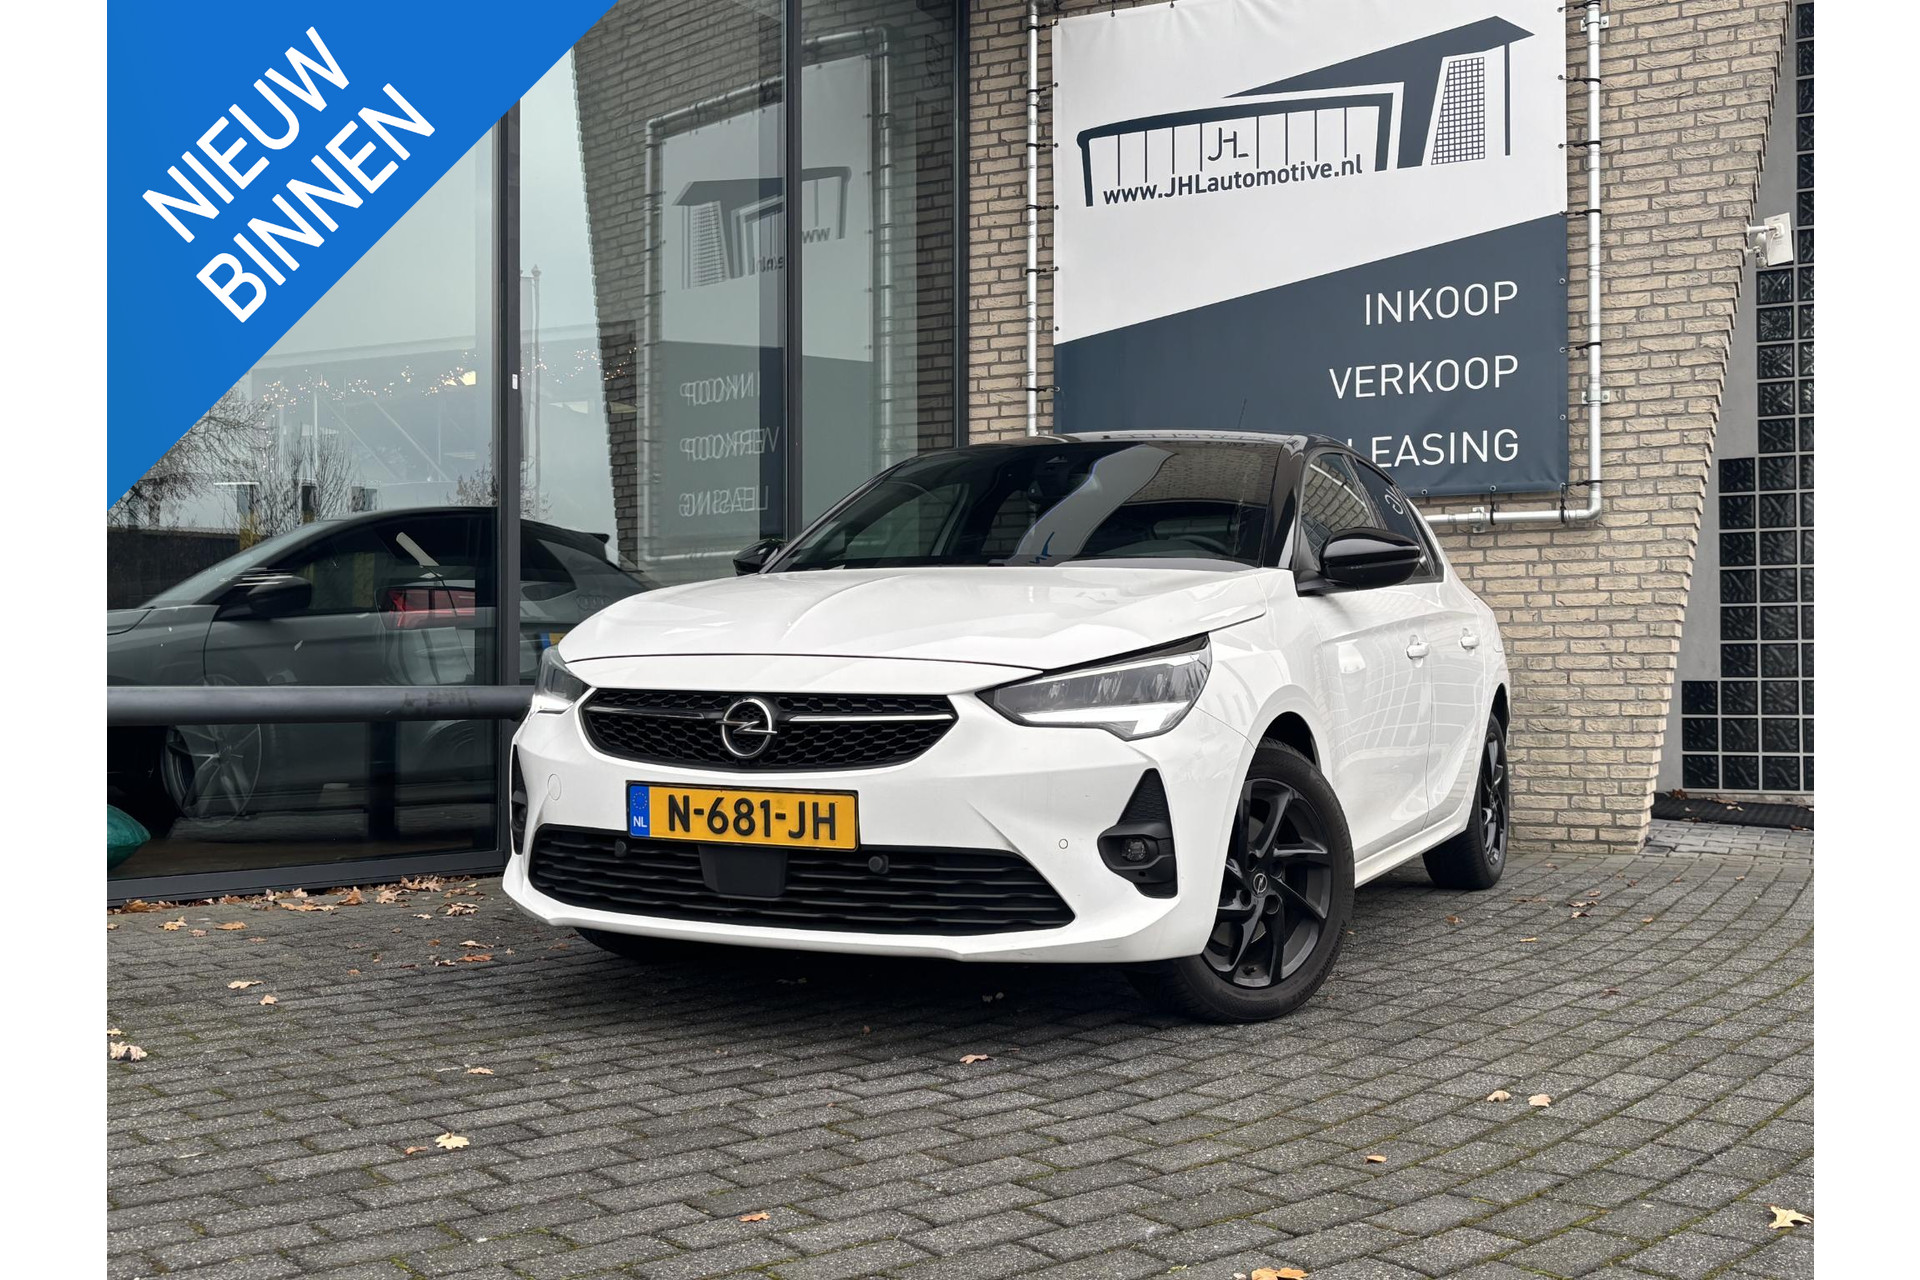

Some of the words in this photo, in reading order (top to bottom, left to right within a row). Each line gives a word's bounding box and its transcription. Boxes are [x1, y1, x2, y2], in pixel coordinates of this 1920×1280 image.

[1103, 153, 1363, 205] www.JHLautomotive.nl
[1365, 280, 1518, 326] INKOOP
[1329, 354, 1518, 400] VERKOOP
[1347, 428, 1519, 468] EASING
[633, 815, 647, 828] NL
[667, 794, 837, 841] N-681-JH
